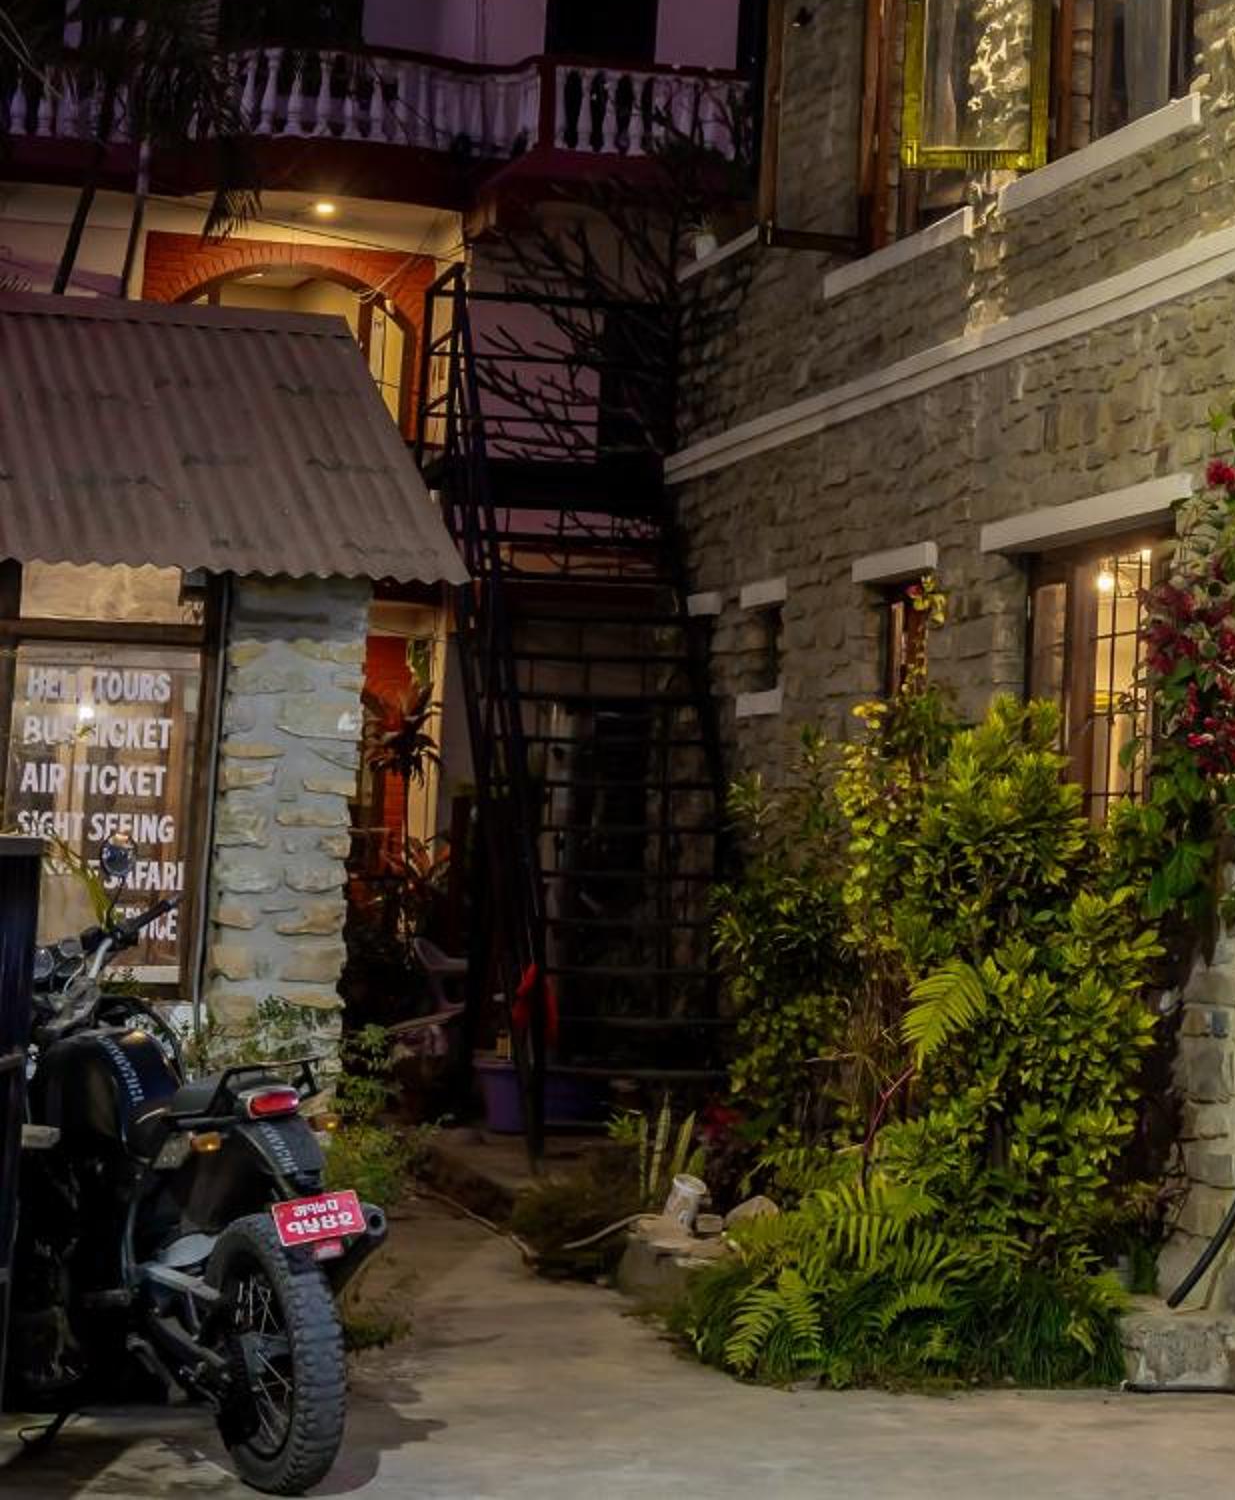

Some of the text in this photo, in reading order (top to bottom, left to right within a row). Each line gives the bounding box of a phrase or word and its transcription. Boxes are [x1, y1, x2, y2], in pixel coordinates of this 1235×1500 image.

[94, 670, 171, 702] TOURS
[20, 762, 167, 796] AIR TICKET
[18, 809, 175, 843] SIGHT SEEING
